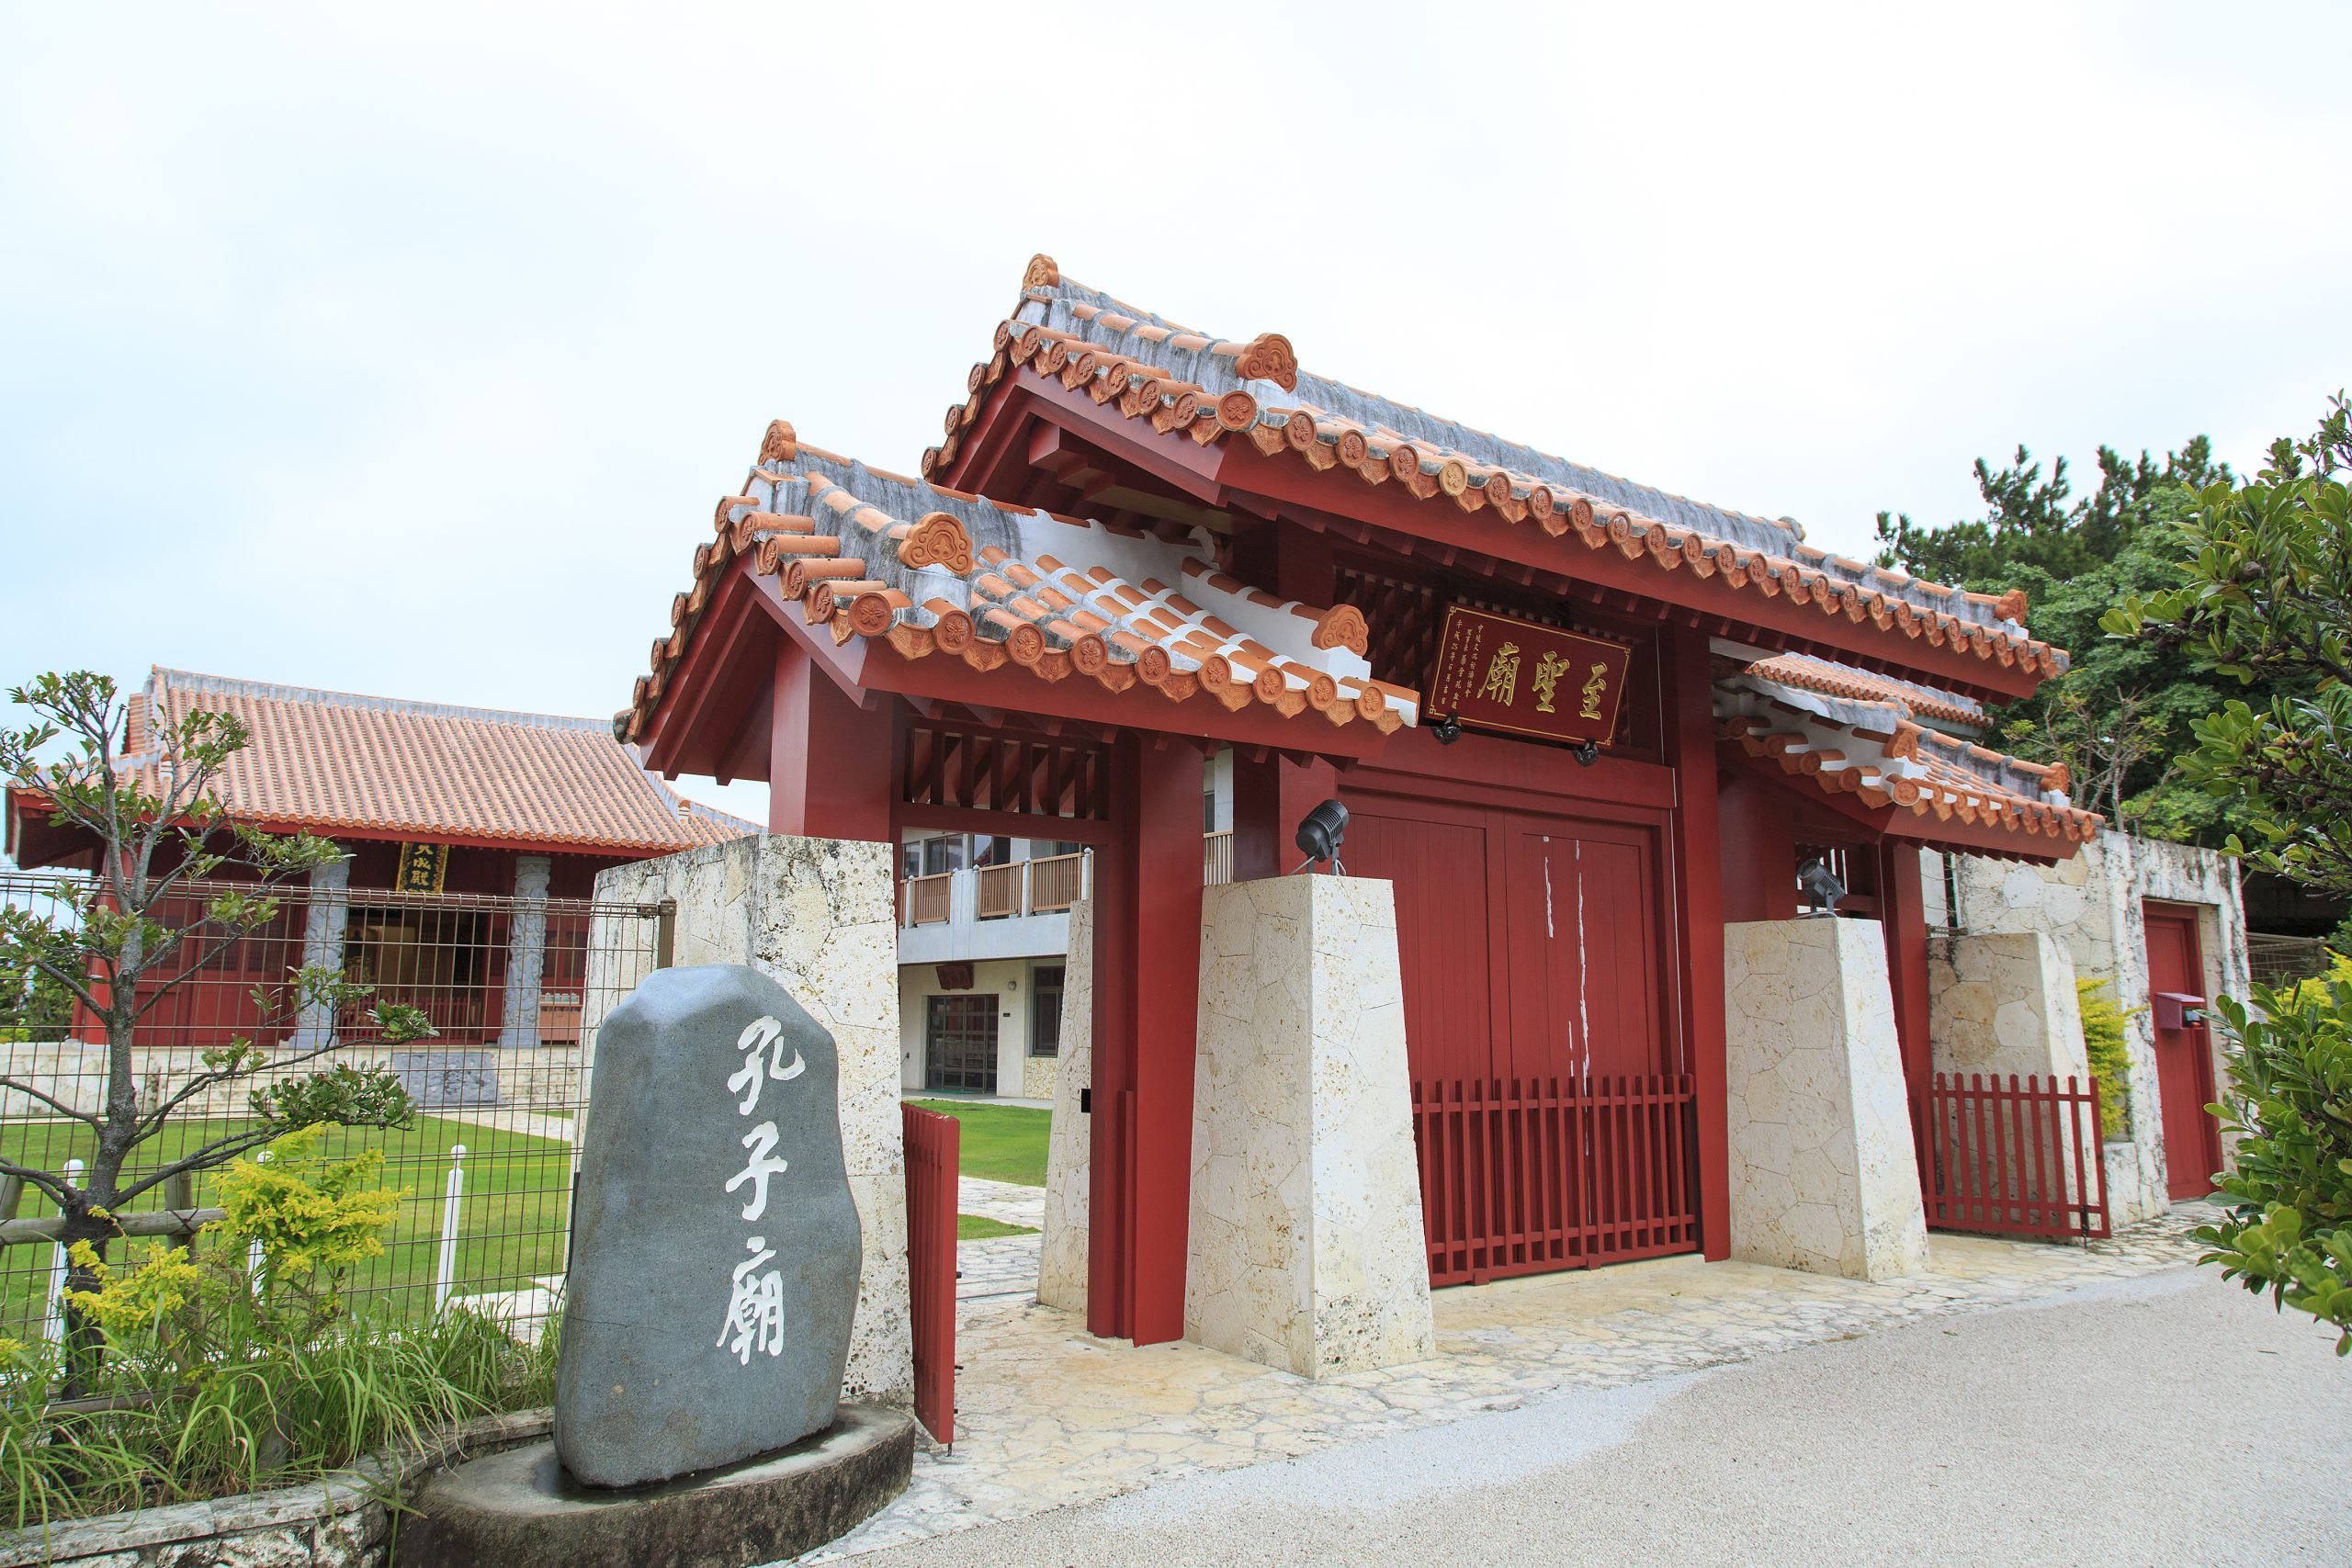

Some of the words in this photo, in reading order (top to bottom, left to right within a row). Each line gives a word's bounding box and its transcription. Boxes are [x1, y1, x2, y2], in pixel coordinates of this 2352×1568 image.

[1476, 641, 1609, 721] 至聖廟
[411, 844, 434, 886] 大成殿
[716, 1015, 806, 1366] 孔子廟
